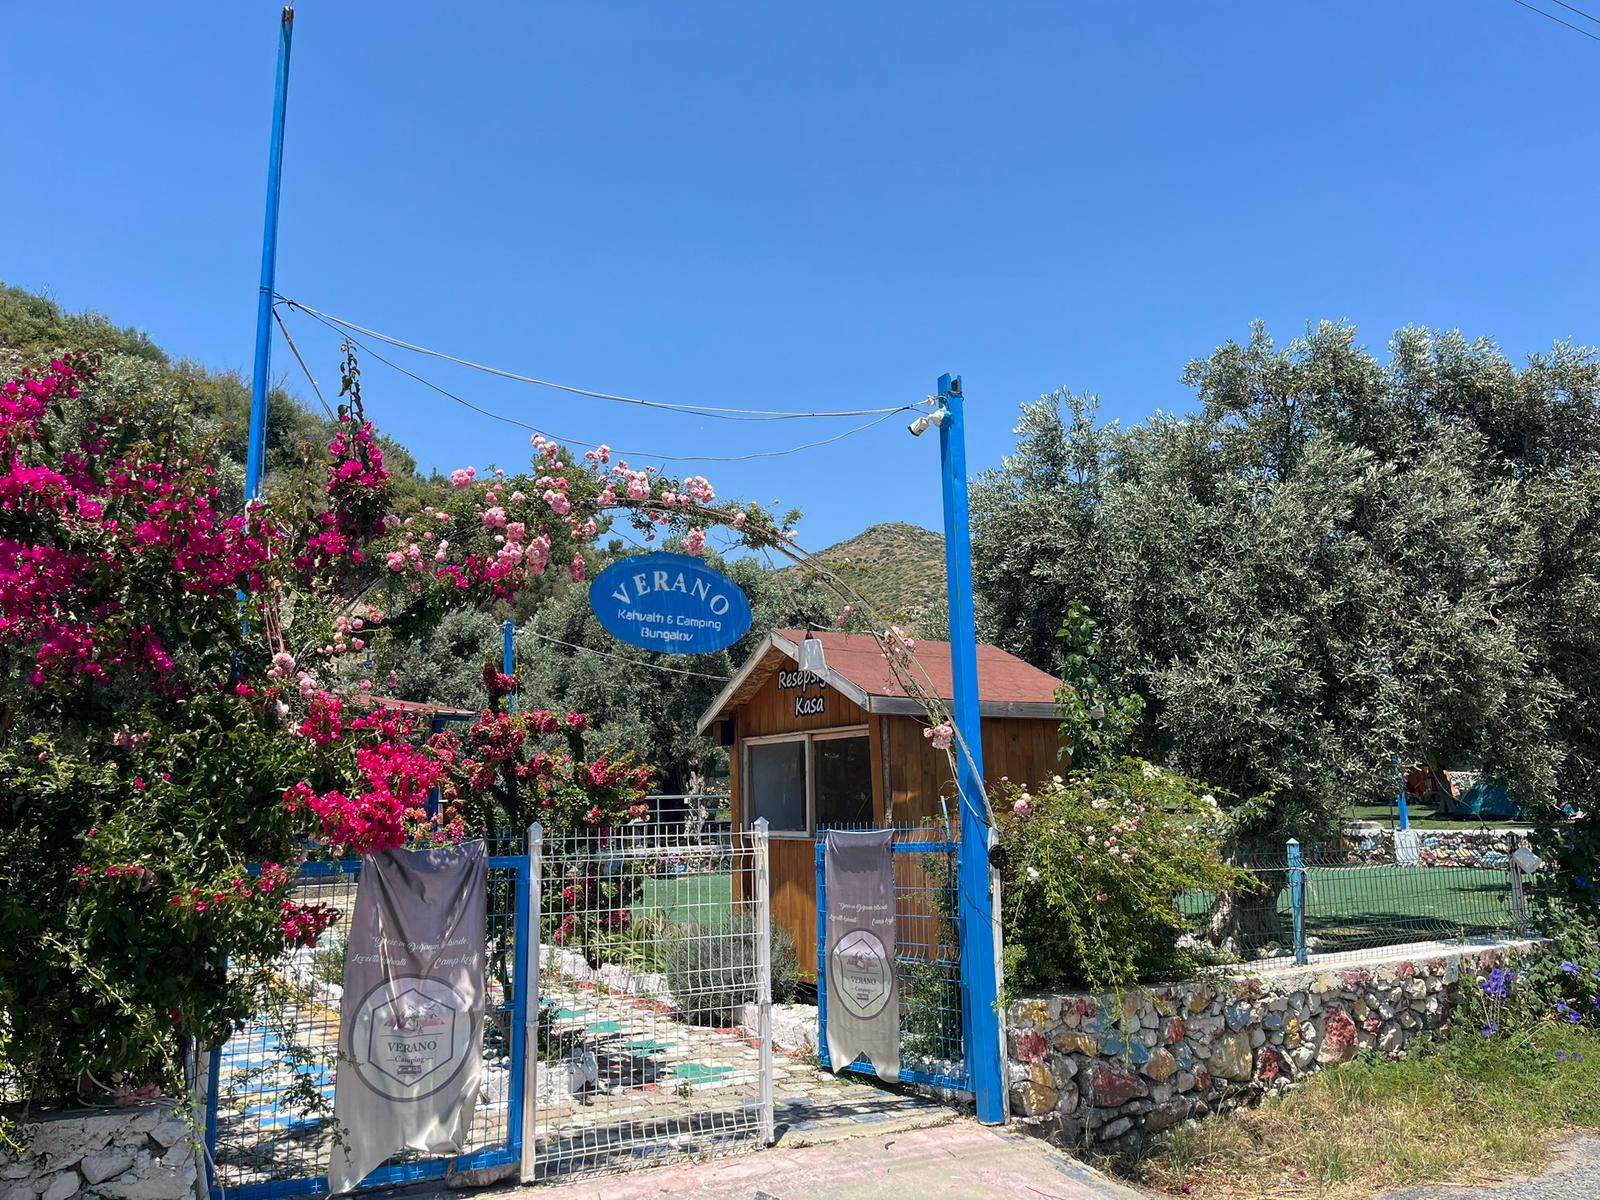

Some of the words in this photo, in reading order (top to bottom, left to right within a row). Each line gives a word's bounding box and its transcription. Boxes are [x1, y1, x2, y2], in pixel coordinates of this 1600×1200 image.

[612, 571, 729, 615] VERANO
[666, 615, 673, 624] &
[677, 616, 721, 631] Camping
[641, 627, 694, 642] Bungalov
[795, 697, 824, 716] Kasa
[850, 975, 877, 986] VERANO
[387, 1040, 437, 1054] VERANO
[394, 1055, 425, 1065] Camping
